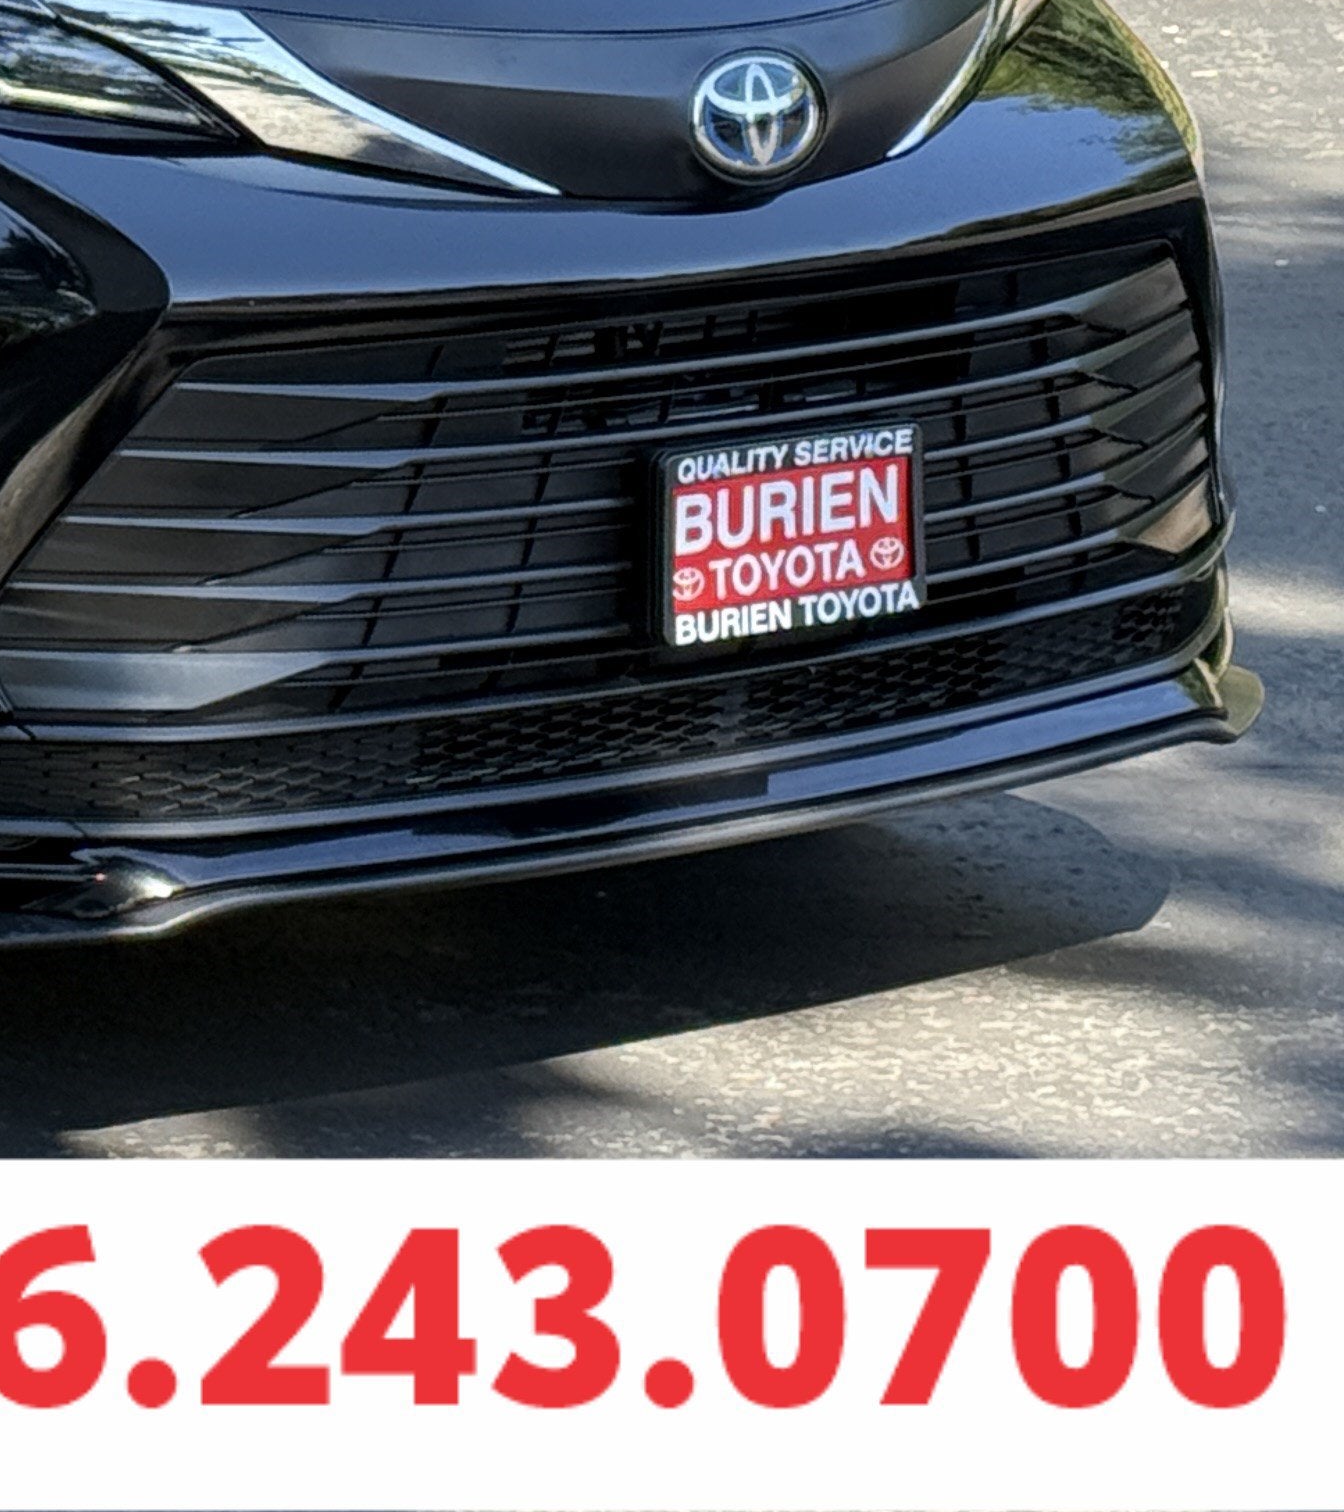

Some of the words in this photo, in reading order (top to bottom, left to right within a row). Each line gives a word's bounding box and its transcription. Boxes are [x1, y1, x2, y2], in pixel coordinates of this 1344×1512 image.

[677, 443, 790, 484] QUALITY
[793, 428, 914, 467] SERVICE
[674, 463, 900, 558] BURIEN
[708, 538, 867, 601] TOYOTA
[673, 598, 793, 647] BURIEN
[798, 579, 922, 627] TOYOTA
